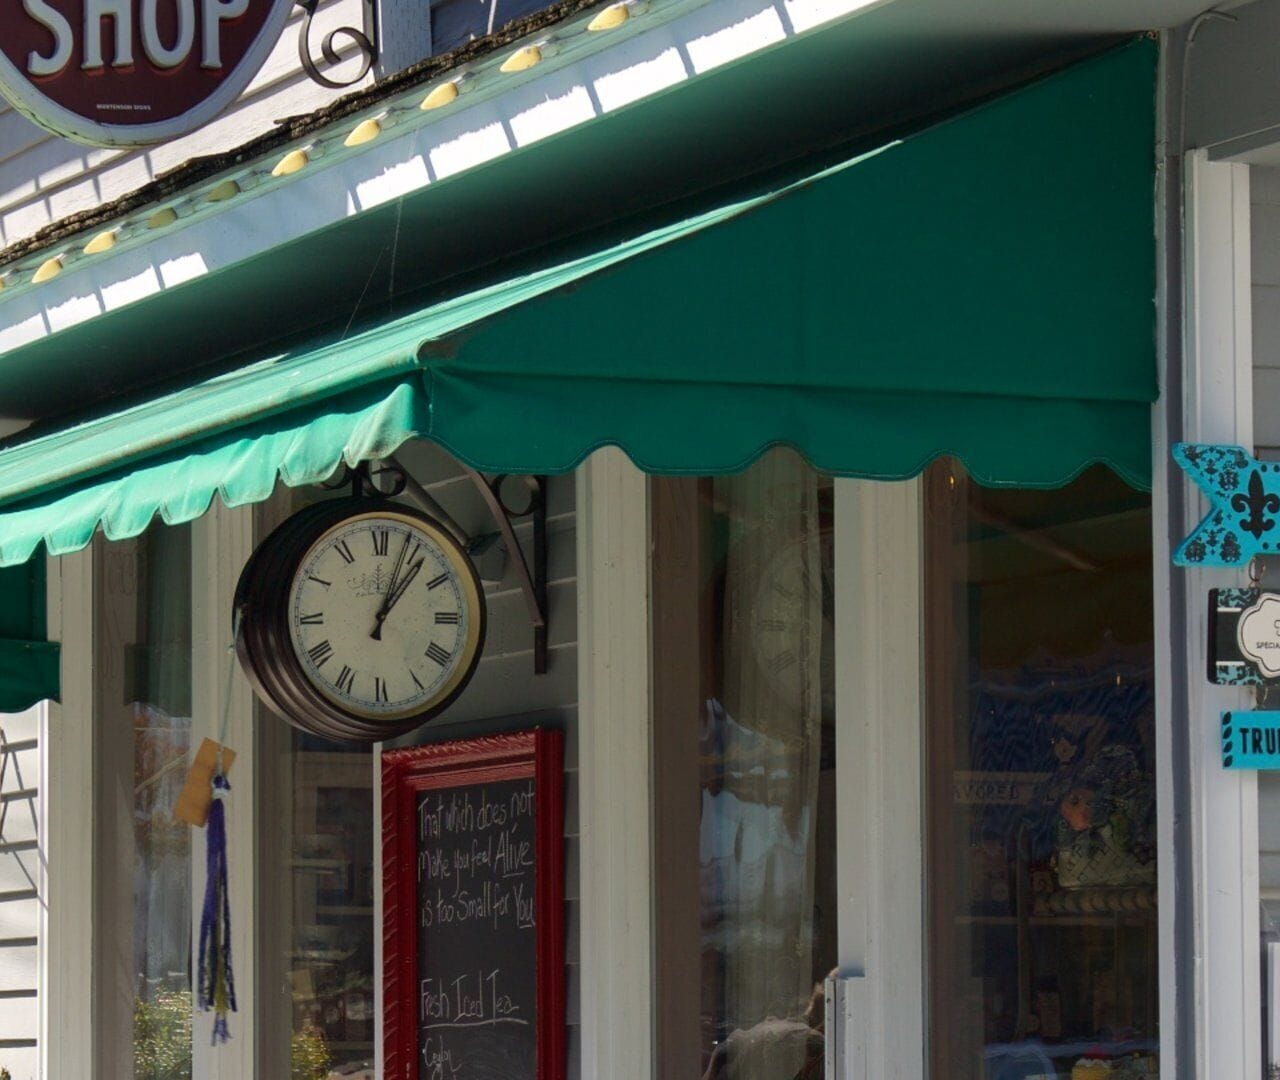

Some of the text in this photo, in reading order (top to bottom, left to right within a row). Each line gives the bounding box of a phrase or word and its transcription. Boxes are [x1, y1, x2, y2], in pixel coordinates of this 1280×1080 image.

[26, 0, 250, 77] SHOP
[418, 795, 444, 841] That
[477, 789, 507, 831] does
[511, 781, 535, 818] not
[453, 848, 470, 899] you
[471, 836, 492, 878] feel
[493, 822, 533, 875] Alive
[421, 880, 535, 931] is too Small for You
[421, 969, 520, 1022] Fresh Iced Tea
